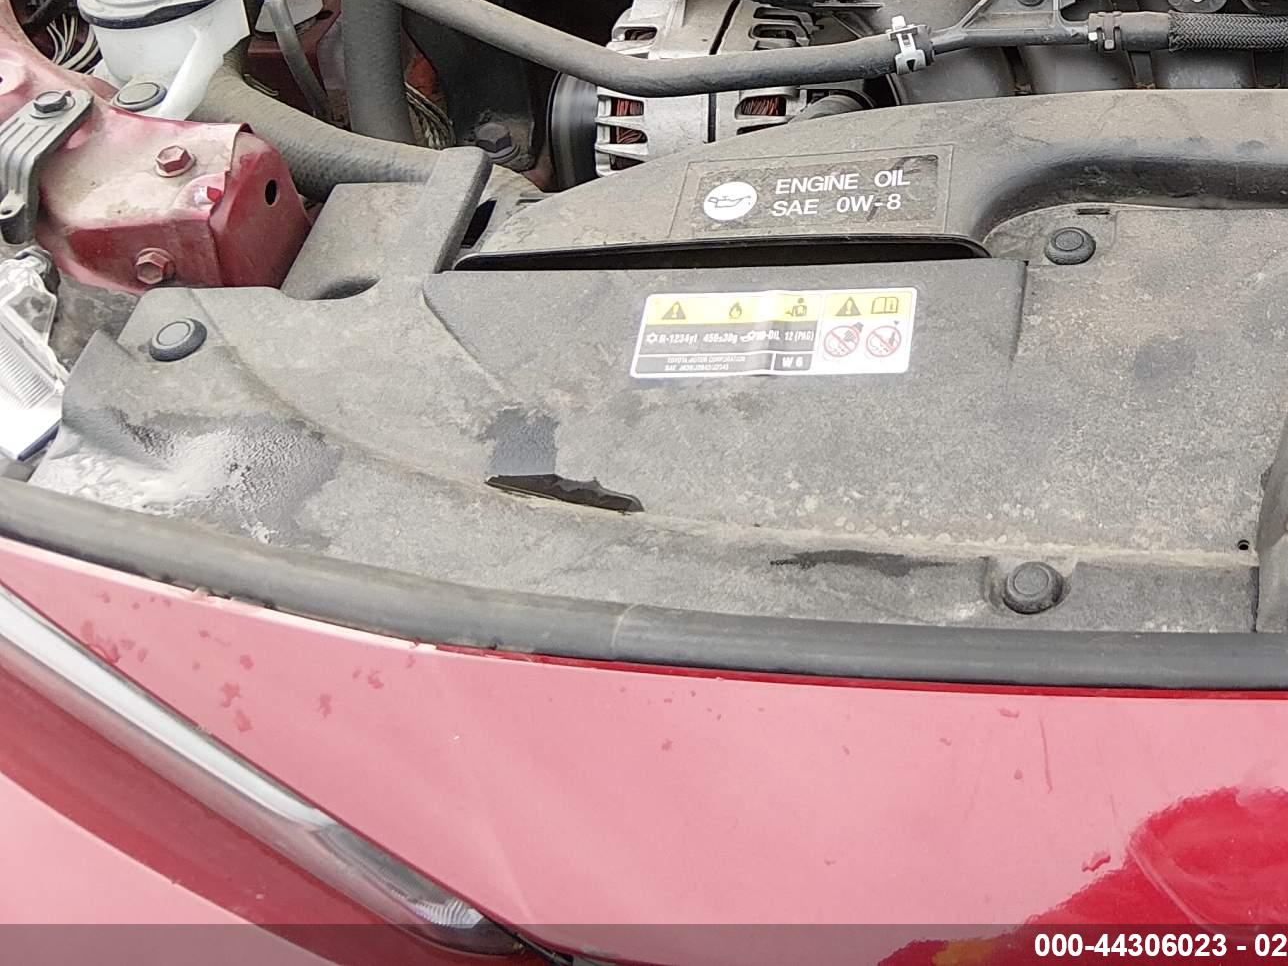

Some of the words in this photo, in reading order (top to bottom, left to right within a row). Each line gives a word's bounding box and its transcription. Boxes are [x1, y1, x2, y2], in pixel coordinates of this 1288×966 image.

[775, 172, 860, 194] ENGINE
[874, 169, 911, 188] OIL
[771, 198, 820, 217] SAE
[836, 193, 901, 213] 0W-8
